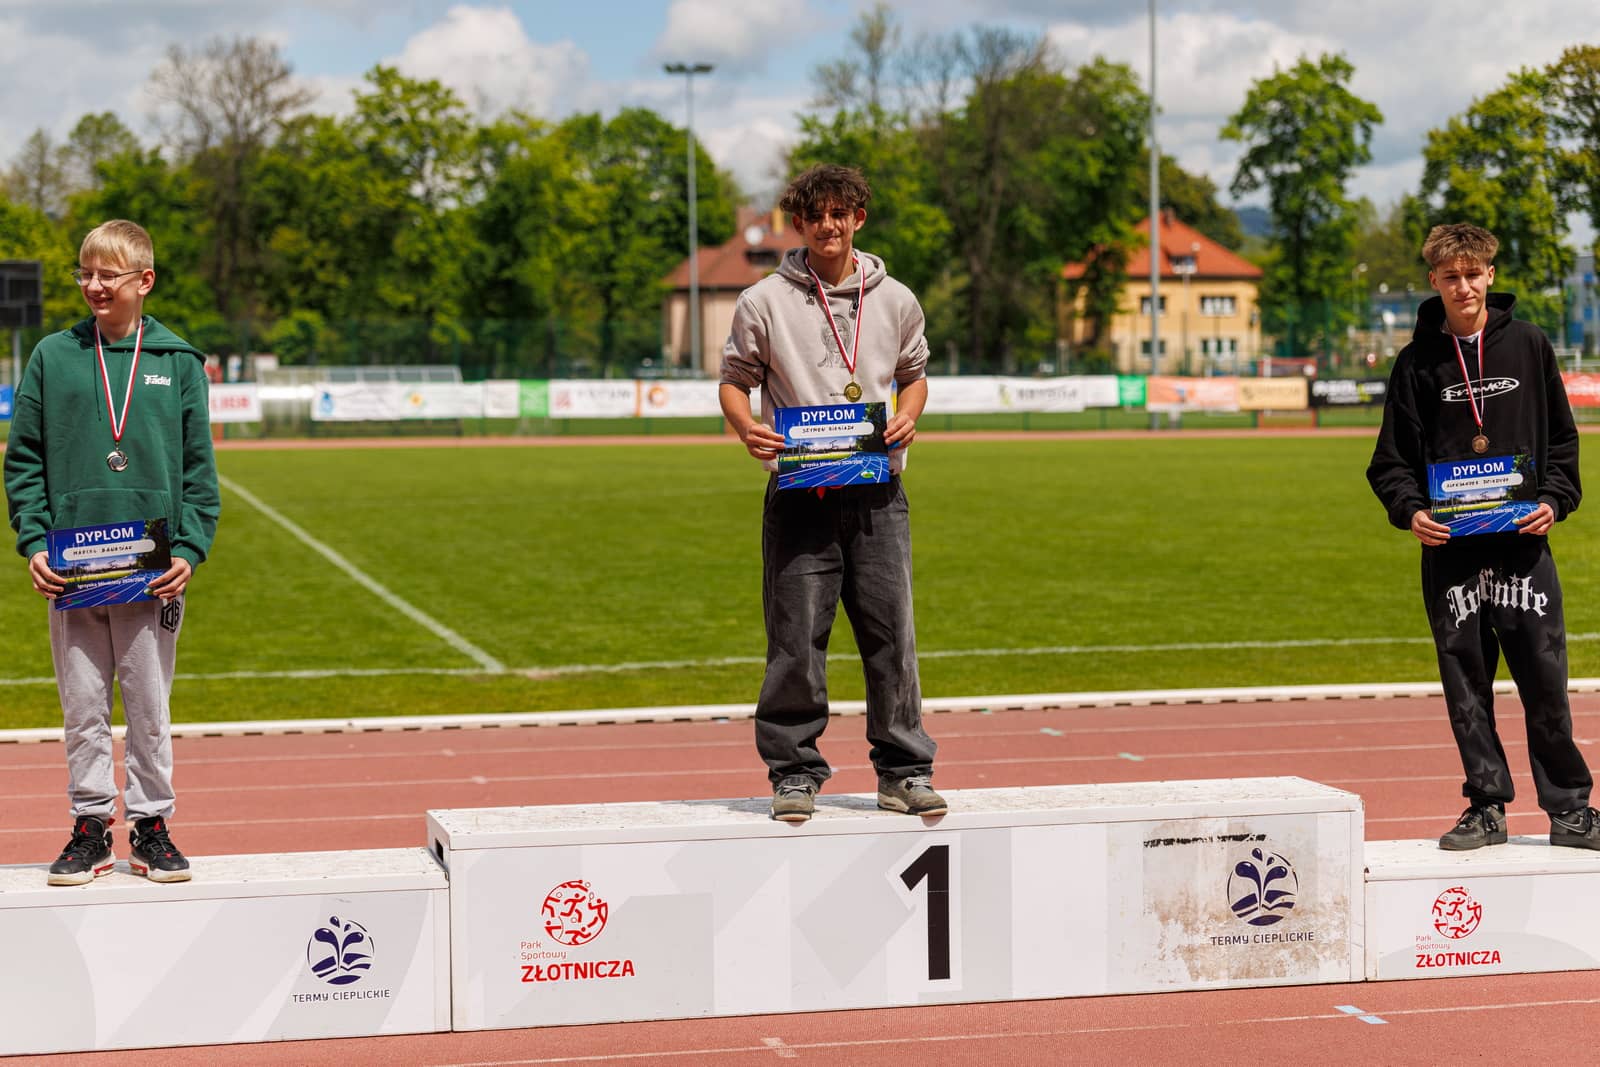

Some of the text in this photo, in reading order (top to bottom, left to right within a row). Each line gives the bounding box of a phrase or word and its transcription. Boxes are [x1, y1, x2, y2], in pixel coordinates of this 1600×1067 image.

[801, 409, 855, 423] DYPLOM
[1452, 462, 1505, 477] DYPLOM
[75, 527, 134, 543] DYPLOM
[900, 844, 950, 980] 1
[521, 940, 542, 949] Park
[1210, 931, 1315, 946] TERMY CIEPLICKIE
[1416, 943, 1451, 951] Sportowy
[521, 951, 567, 960] Sportowy
[1416, 950, 1502, 968] ZŁOTNICZA
[521, 959, 635, 982] ZŁOTNICZA
[292, 989, 391, 1003] TERMY CIEPLICKIE
